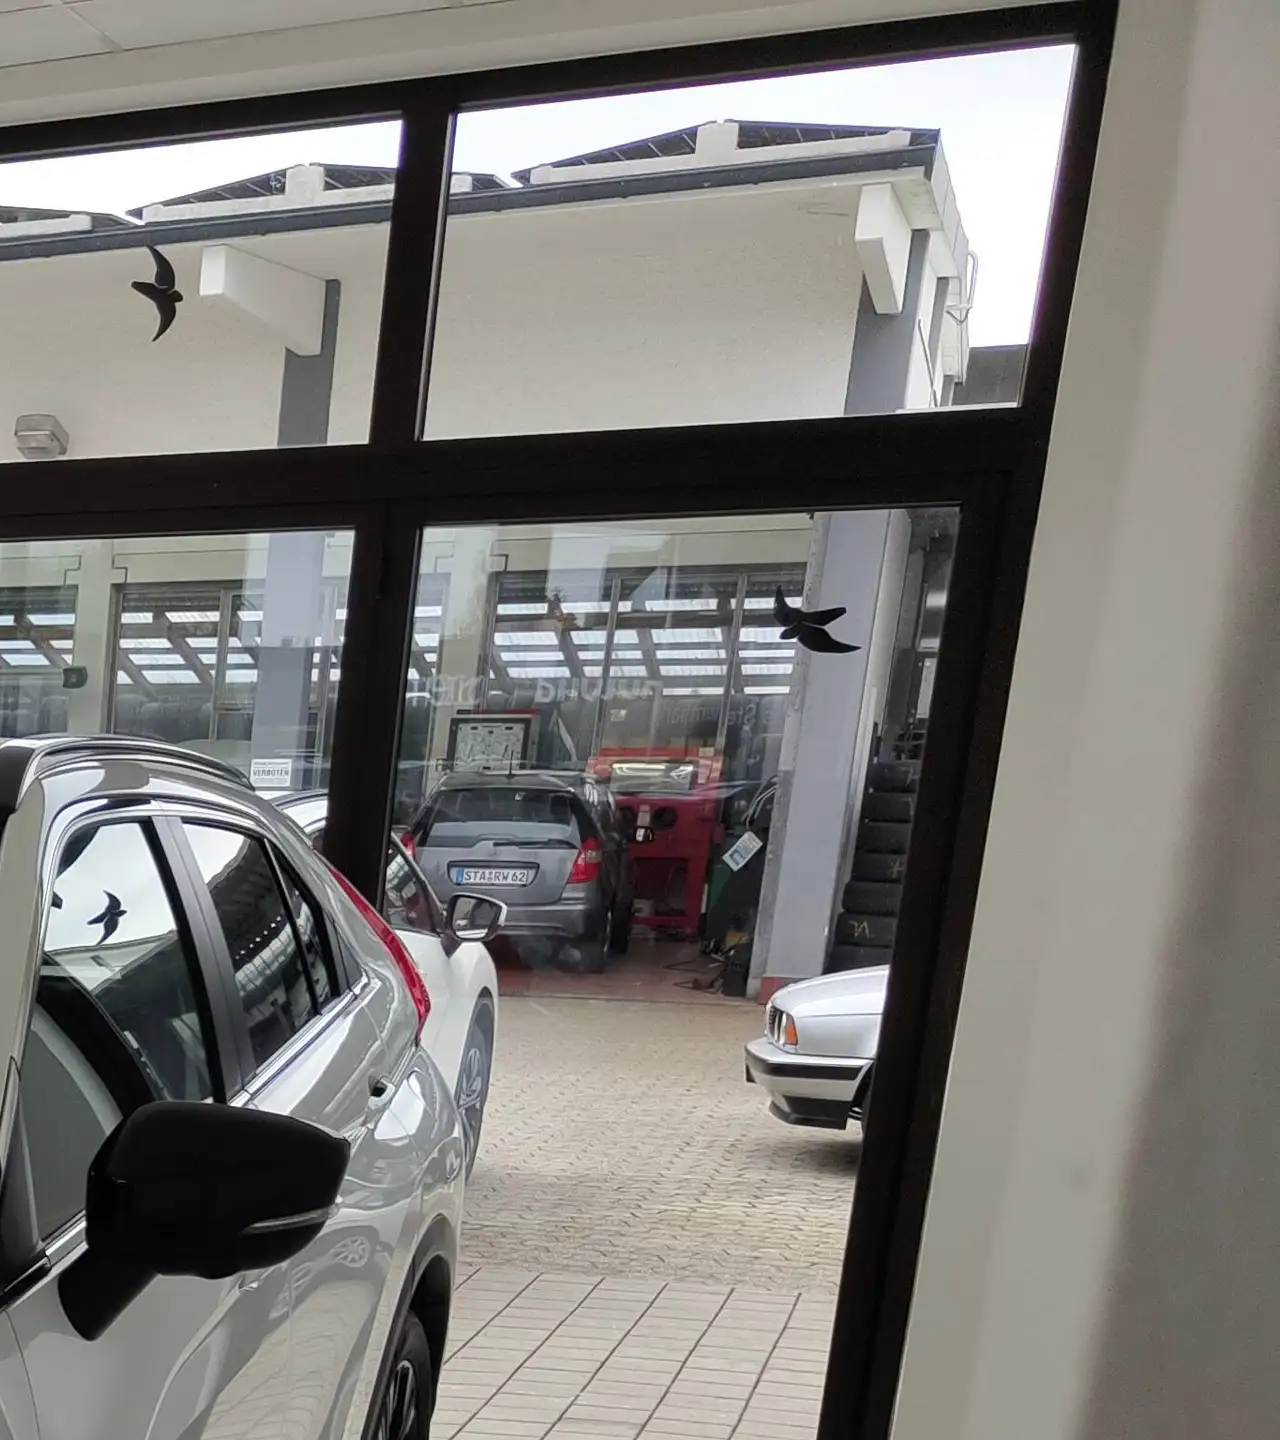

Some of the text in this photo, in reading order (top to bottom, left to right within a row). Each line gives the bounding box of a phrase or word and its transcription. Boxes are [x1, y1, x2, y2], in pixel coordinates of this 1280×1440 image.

[463, 870, 526, 883] STA RW 62
